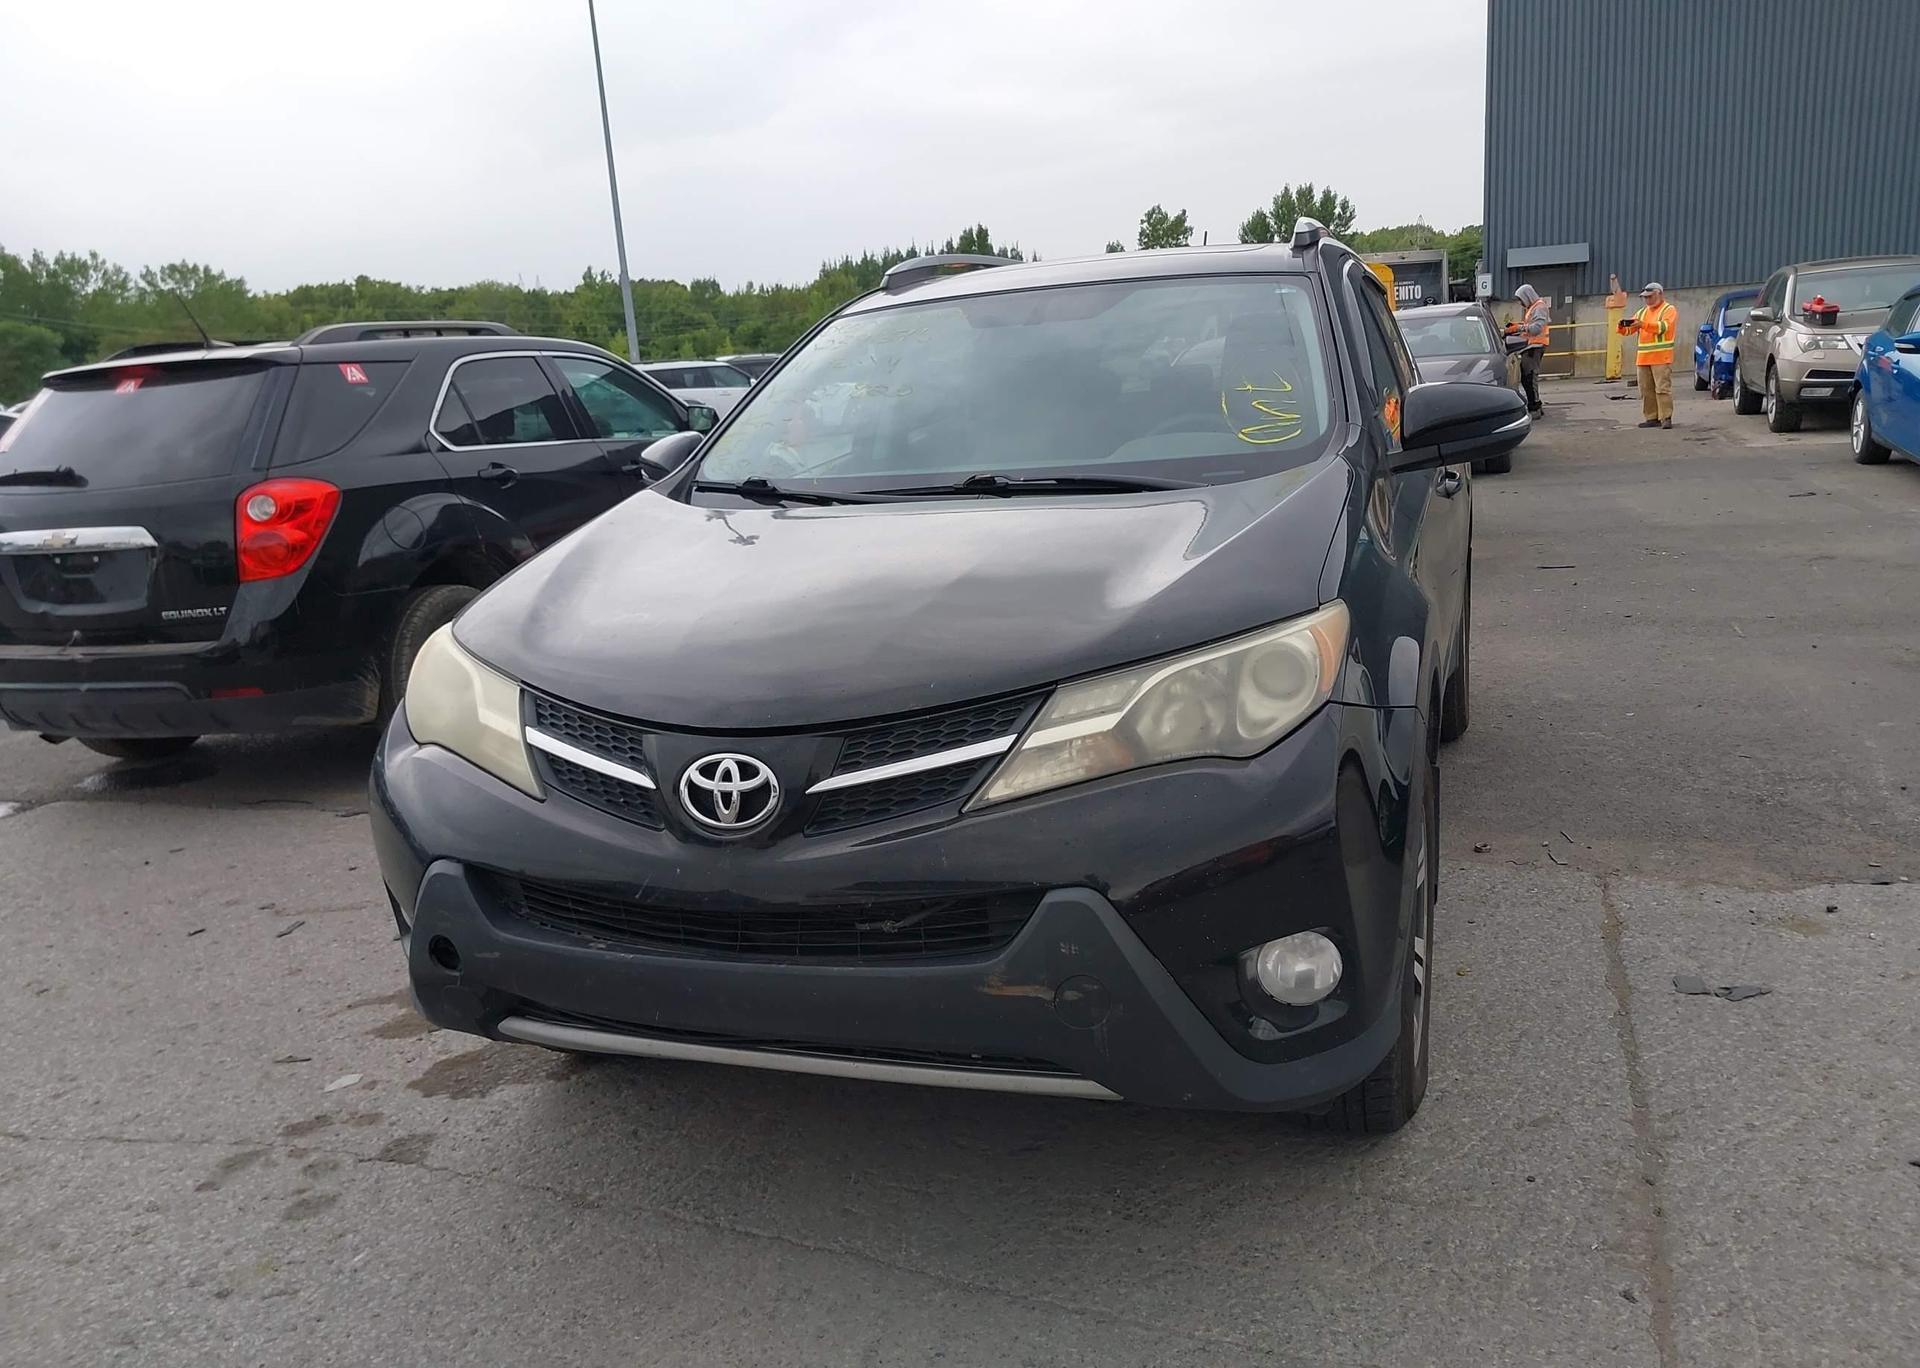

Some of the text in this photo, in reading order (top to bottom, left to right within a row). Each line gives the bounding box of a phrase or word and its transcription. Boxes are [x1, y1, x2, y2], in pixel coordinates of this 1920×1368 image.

[1481, 281, 1487, 289] G
[1394, 285, 1422, 300] ENITO
[161, 606, 227, 619] EQUINOX LT
